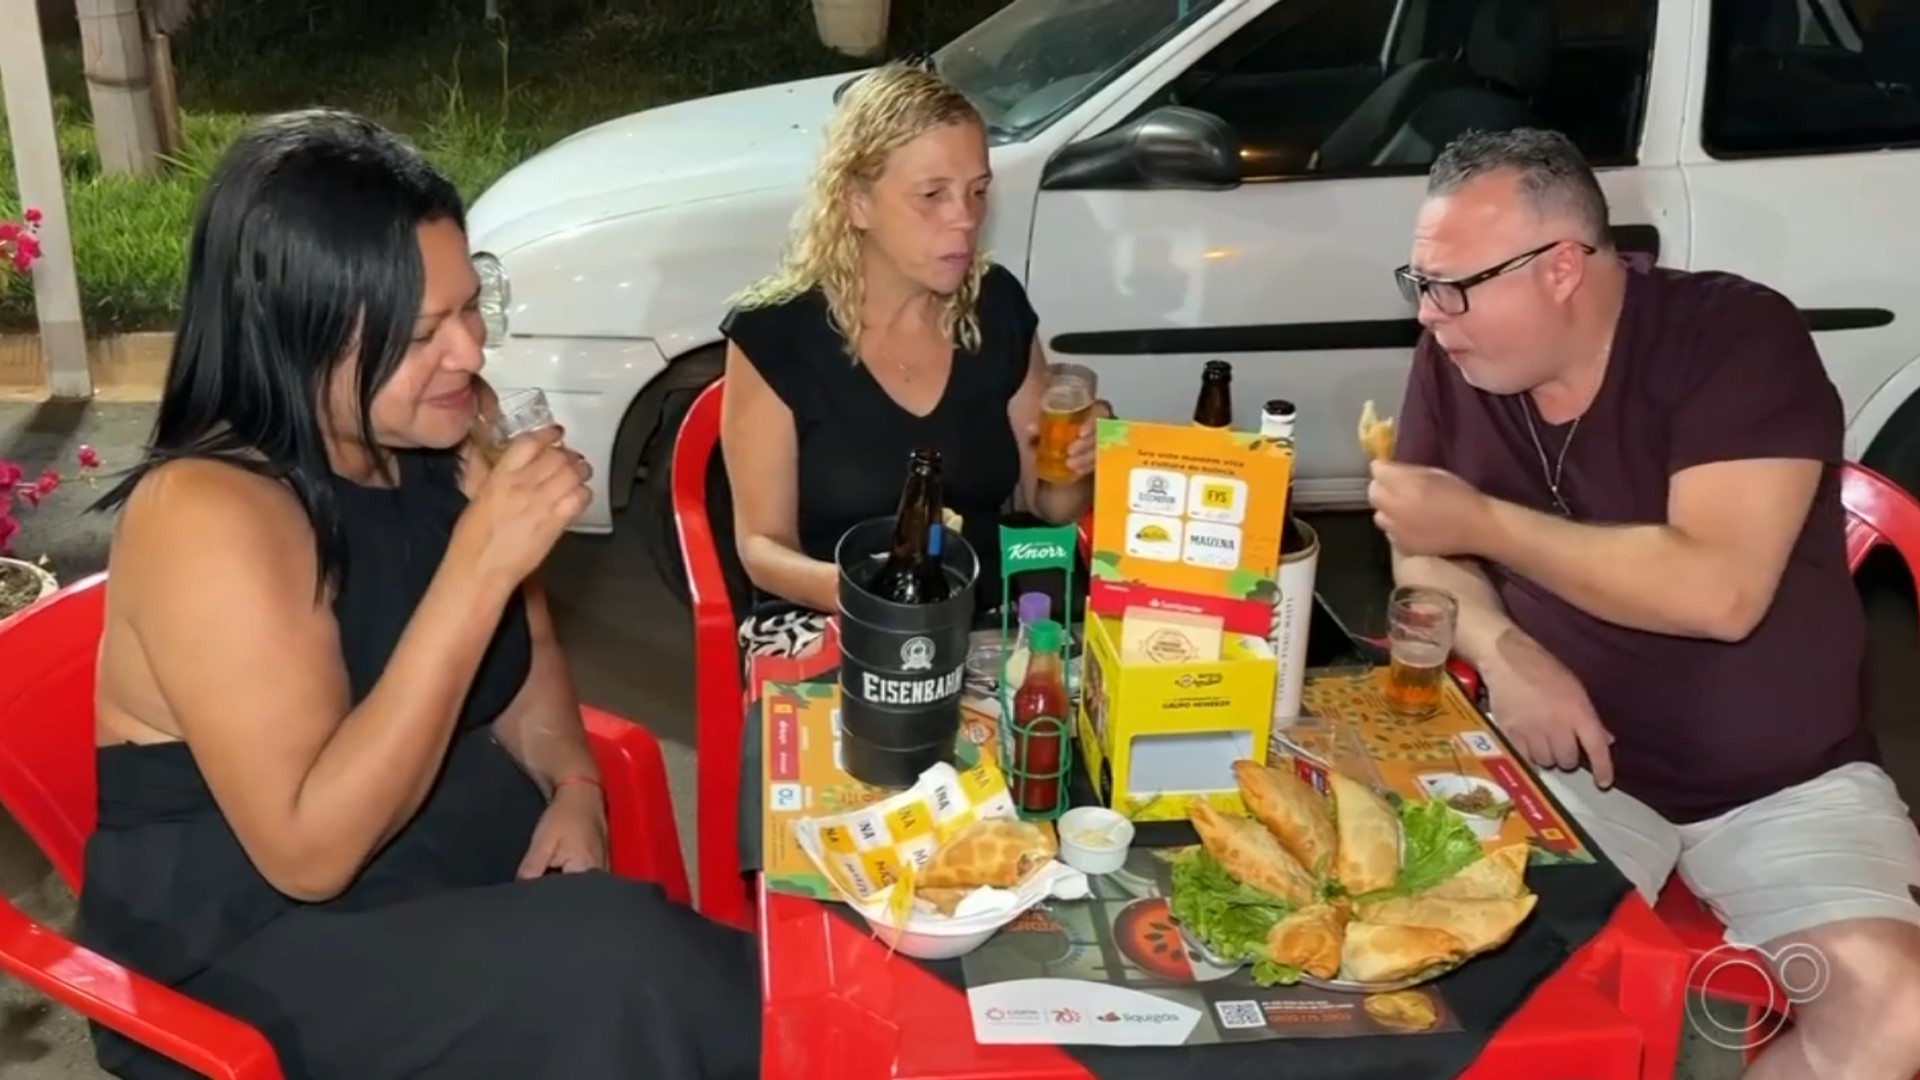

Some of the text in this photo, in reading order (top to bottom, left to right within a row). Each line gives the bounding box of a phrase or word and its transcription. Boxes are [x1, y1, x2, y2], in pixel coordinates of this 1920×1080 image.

[1207, 489, 1227, 503] FYS
[1190, 534, 1235, 550] MAIZENA
[1008, 543, 1068, 560] Knorr
[862, 663, 965, 704] EISENBAHN
